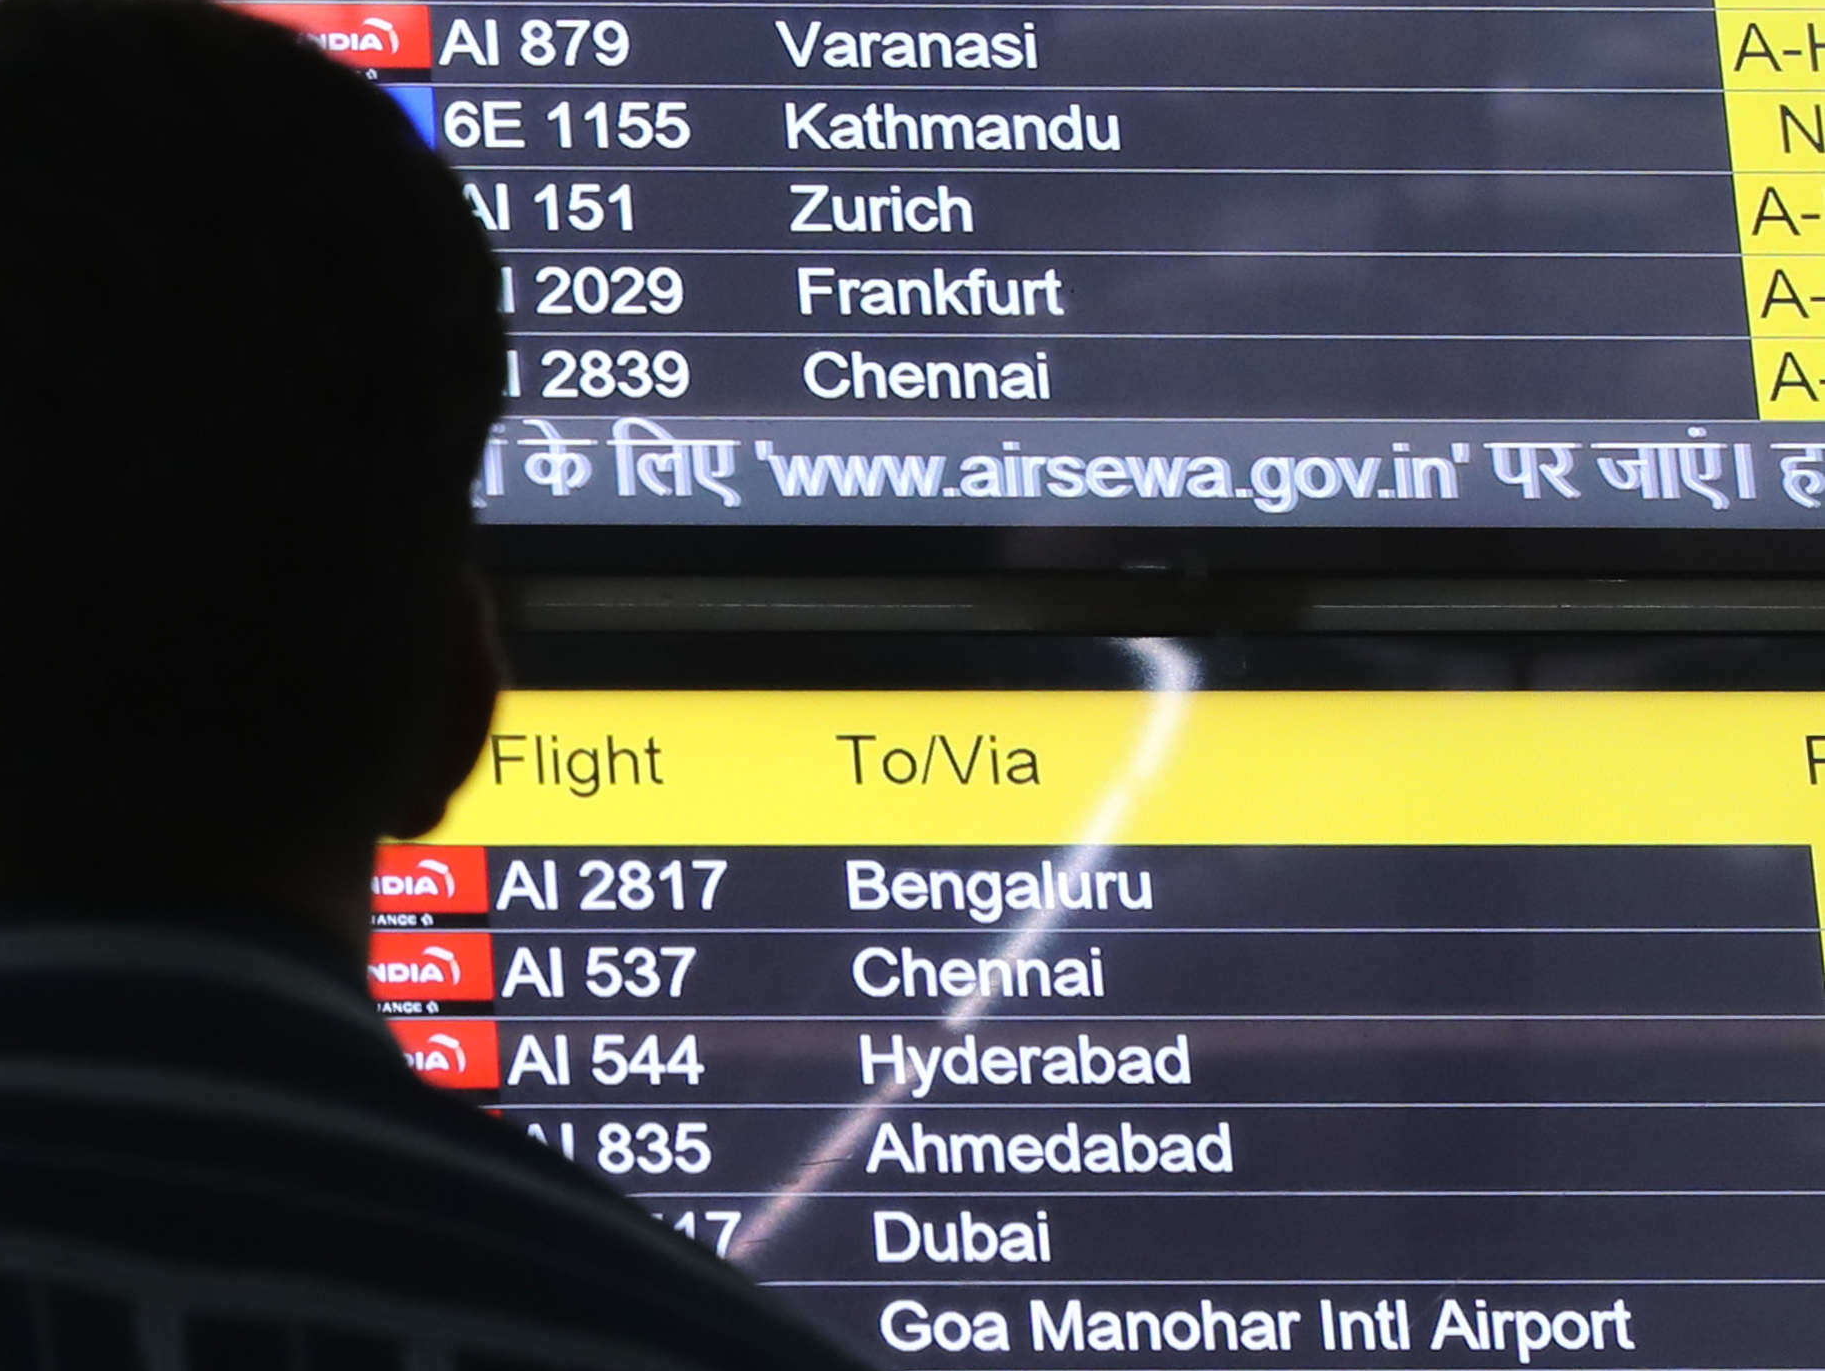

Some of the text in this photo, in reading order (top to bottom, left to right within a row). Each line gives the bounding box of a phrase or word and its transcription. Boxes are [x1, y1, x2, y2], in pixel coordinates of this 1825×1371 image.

[444, 101, 1120, 150] 6E 1155 Kathmandu
[536, 267, 1064, 315] 2029 Frankfurt
[755, 440, 1470, 513] 'www.airsewa.gov.in'
[486, 729, 1040, 797] Flight To/Via
[496, 856, 1152, 929] AI 2817 Bengaluru
[860, 1034, 1190, 1098] Hyderabad
[874, 1211, 1050, 1262] Dubai
[881, 1299, 1635, 1363] Goa Manohar Intl Airport
